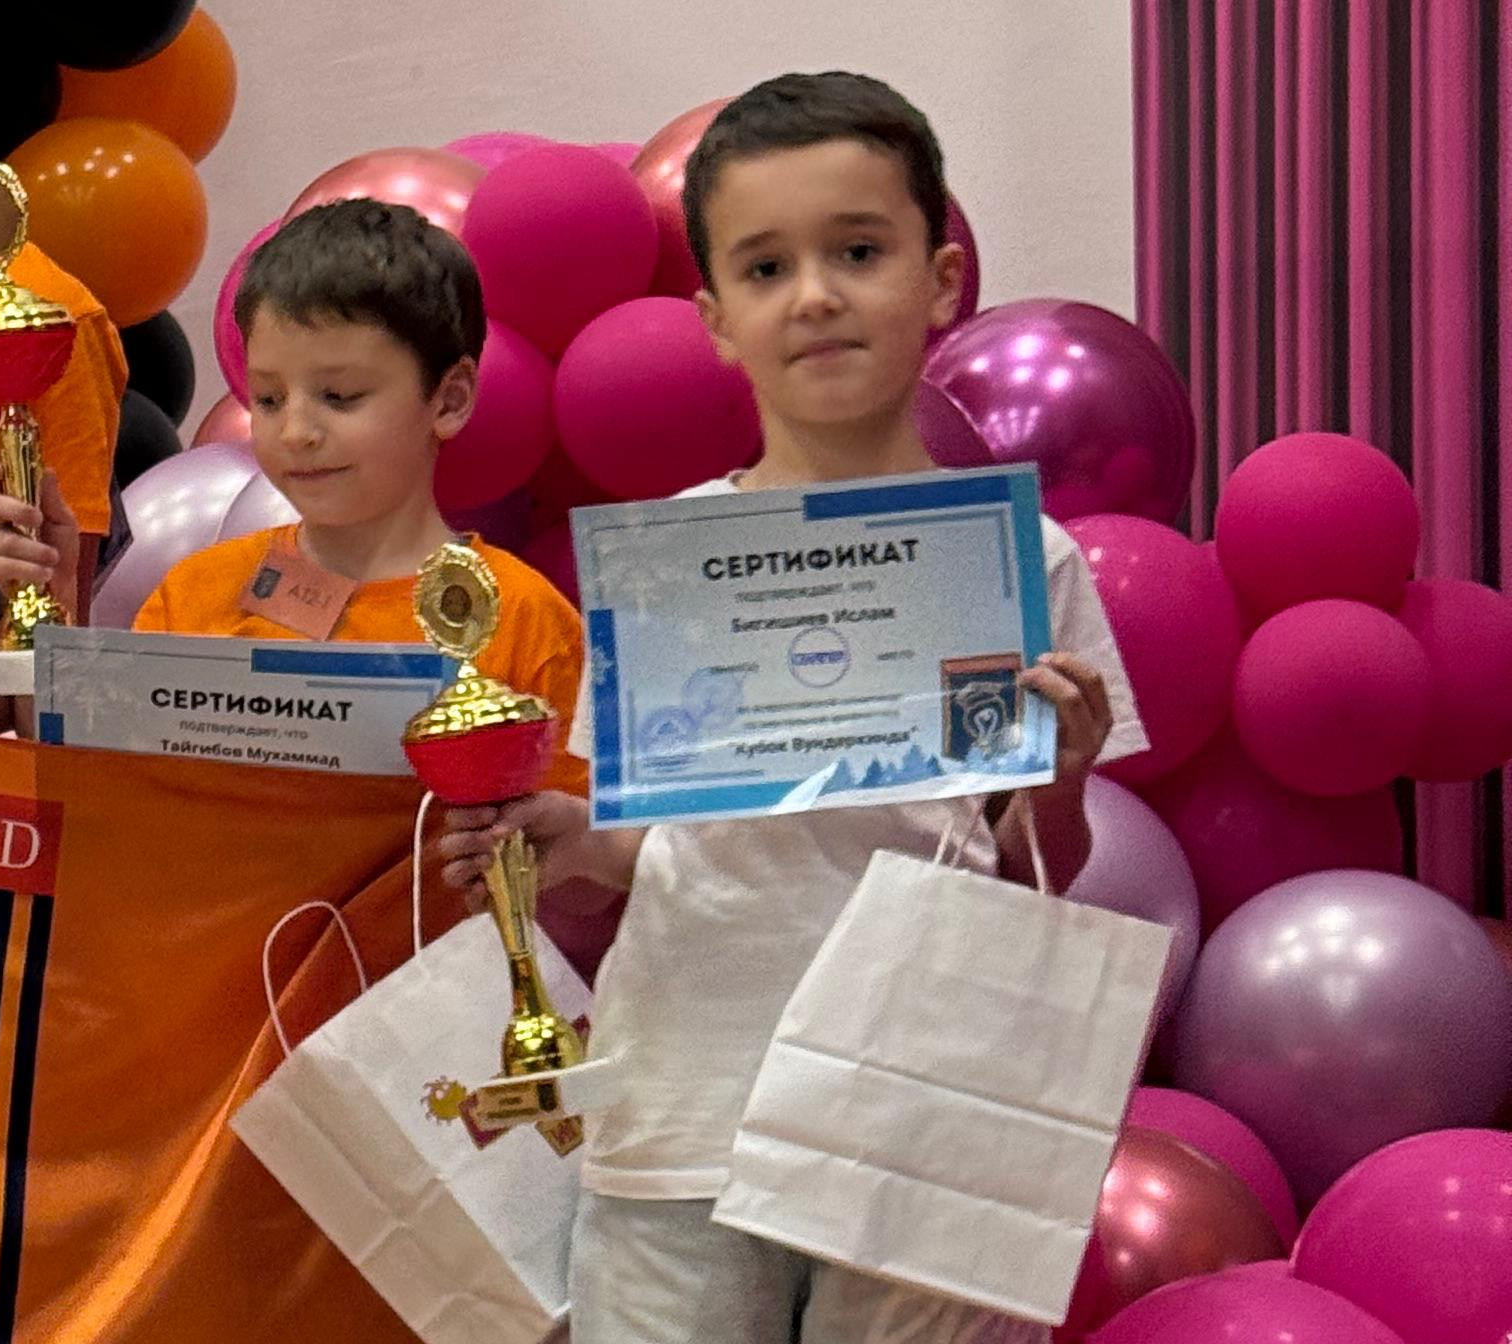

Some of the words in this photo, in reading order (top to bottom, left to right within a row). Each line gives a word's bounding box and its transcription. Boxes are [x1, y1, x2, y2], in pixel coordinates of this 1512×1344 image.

[701, 538, 919, 581] СЕРТИФИКАТ
[150, 687, 353, 723] СЕРТИФИКАТ
[247, 746, 341, 769] Мухаммад
